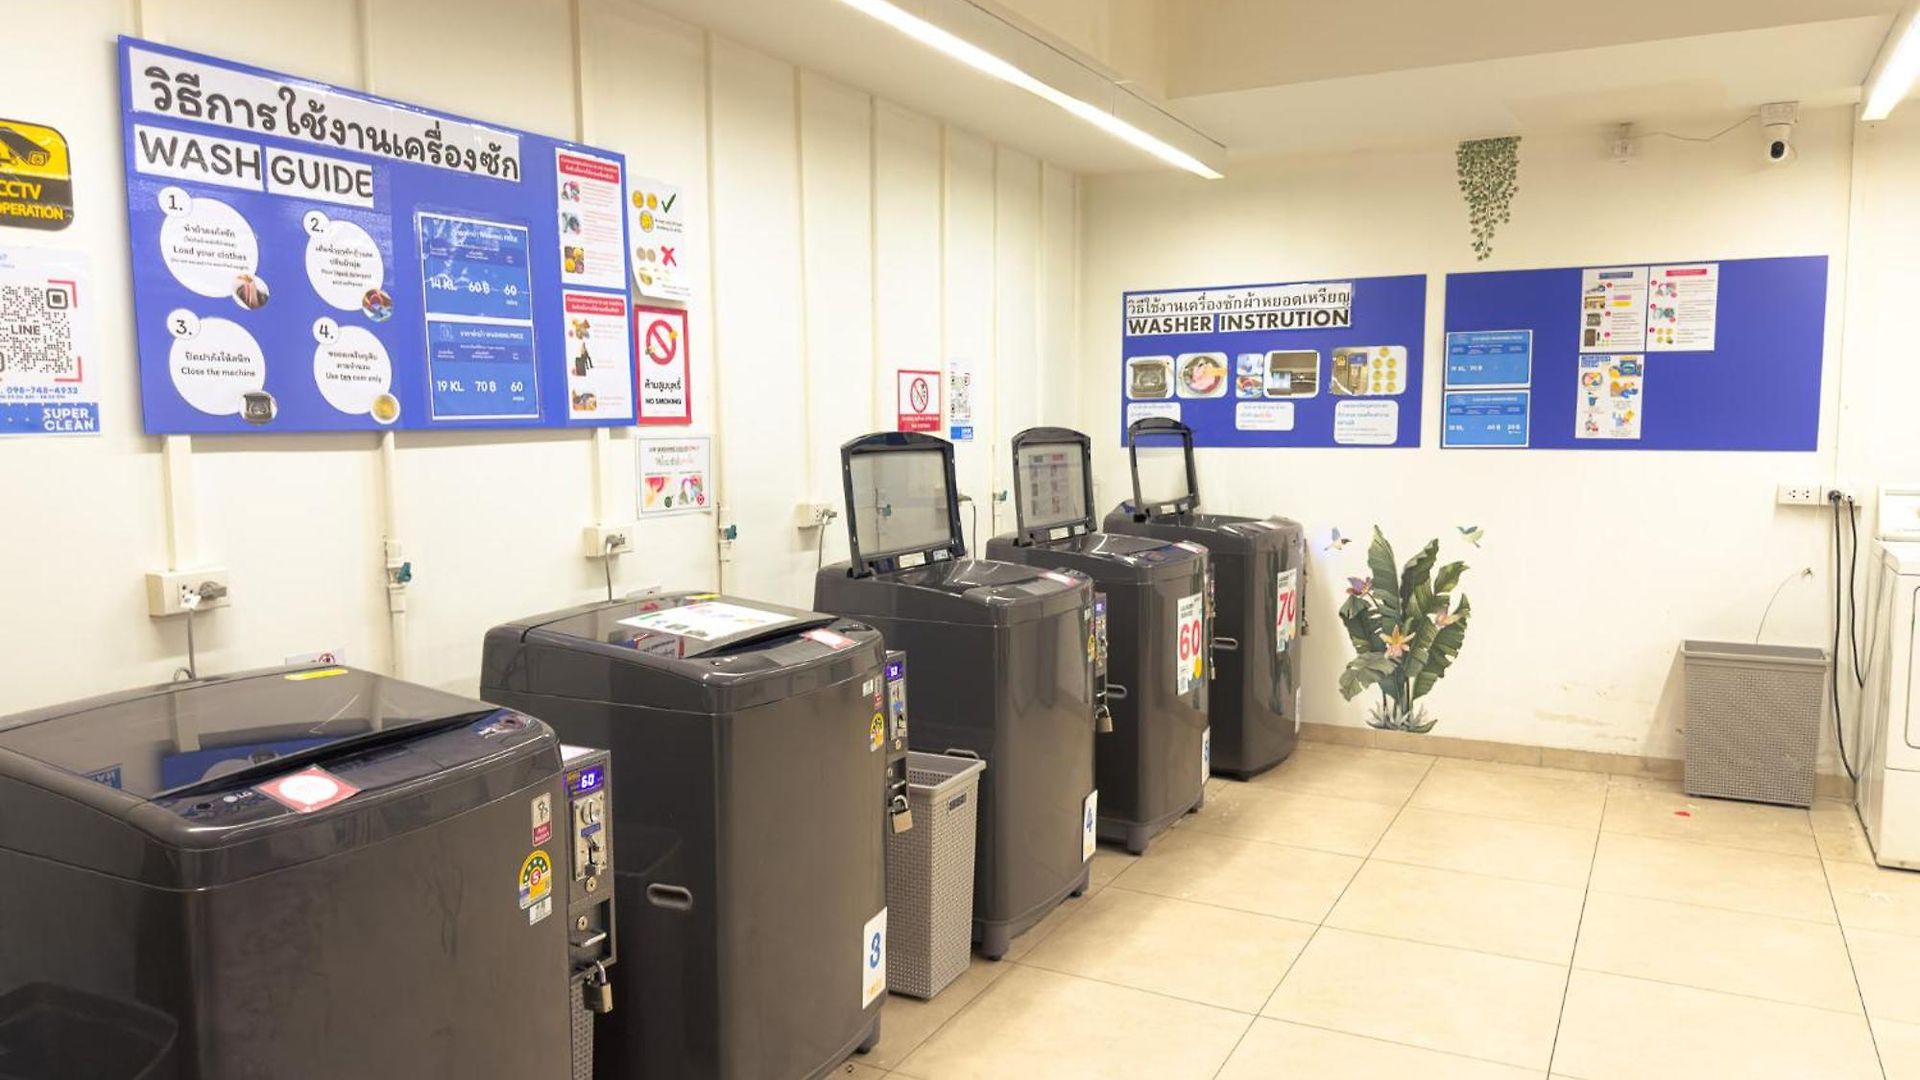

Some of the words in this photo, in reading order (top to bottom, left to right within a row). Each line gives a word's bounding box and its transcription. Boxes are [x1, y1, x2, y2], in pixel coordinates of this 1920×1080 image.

[145, 66, 519, 180] วิธีการใช้งานเครื่องซัก
[139, 131, 262, 180] WASH
[271, 155, 374, 198] GUIDE
[168, 194, 183, 211] 1.
[310, 217, 324, 233] 2.
[173, 245, 194, 255] Load
[196, 249, 215, 258] your
[217, 250, 247, 261] clothes
[1128, 288, 1350, 314] วิธีใช้งานเครื่องซักผ้าหยอดเหรียญ
[175, 319, 192, 336] 3.
[1129, 316, 1212, 334] WASHER
[1220, 309, 1349, 330] INSTRUTION
[11, 325, 40, 335] LINE
[319, 324, 334, 339] 4.
[181, 367, 205, 375] Close
[206, 368, 220, 376] the
[222, 369, 256, 377] machine
[437, 380, 447, 392] 19
[474, 380, 487, 392] 70
[510, 381, 523, 392] 60
[43, 408, 89, 420] SUPER
[44, 418, 95, 431] CLEAN
[1278, 590, 1295, 625] 70
[1179, 620, 1201, 661] 60
[581, 773, 595, 789] 60
[869, 931, 881, 969] 3
